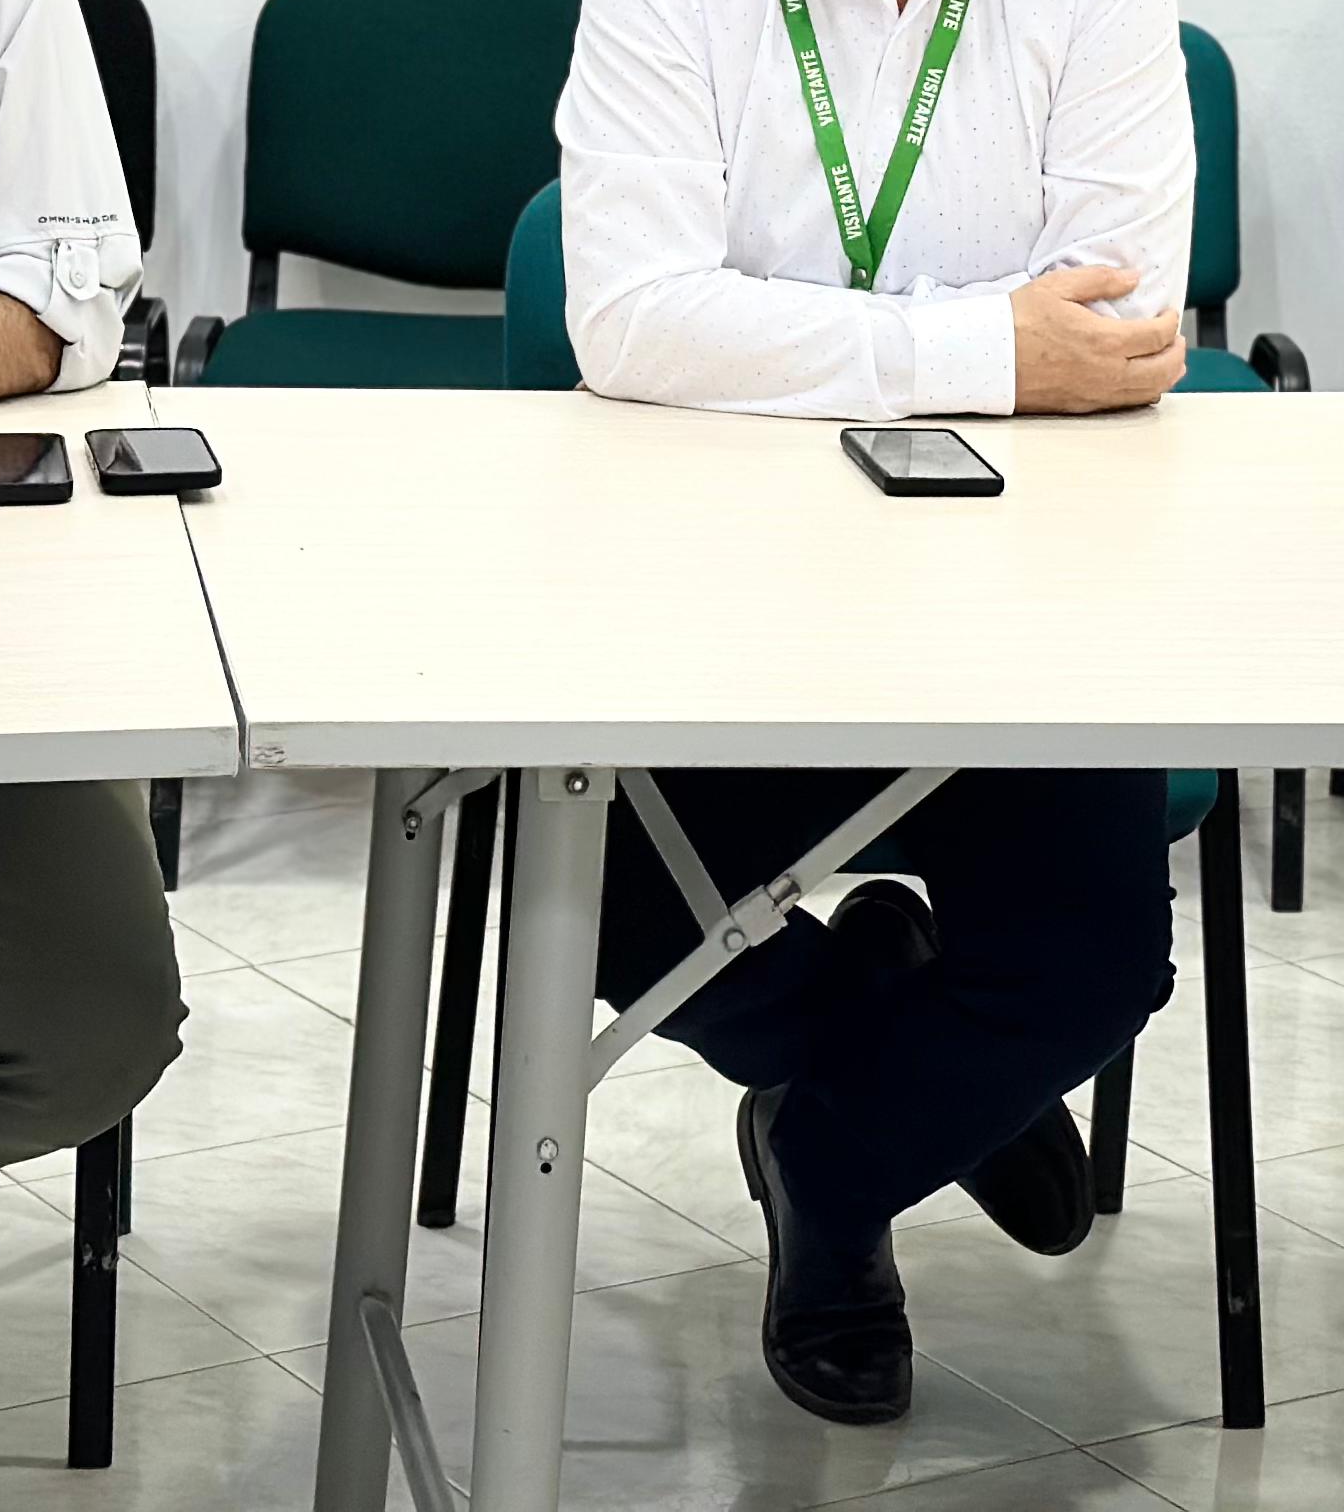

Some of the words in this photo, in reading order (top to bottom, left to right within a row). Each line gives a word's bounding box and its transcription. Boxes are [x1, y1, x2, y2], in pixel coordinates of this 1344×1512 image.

[800, 49, 834, 127] VISITANTE
[906, 68, 944, 146] VISITANTE
[831, 163, 862, 240] VISITANTE
